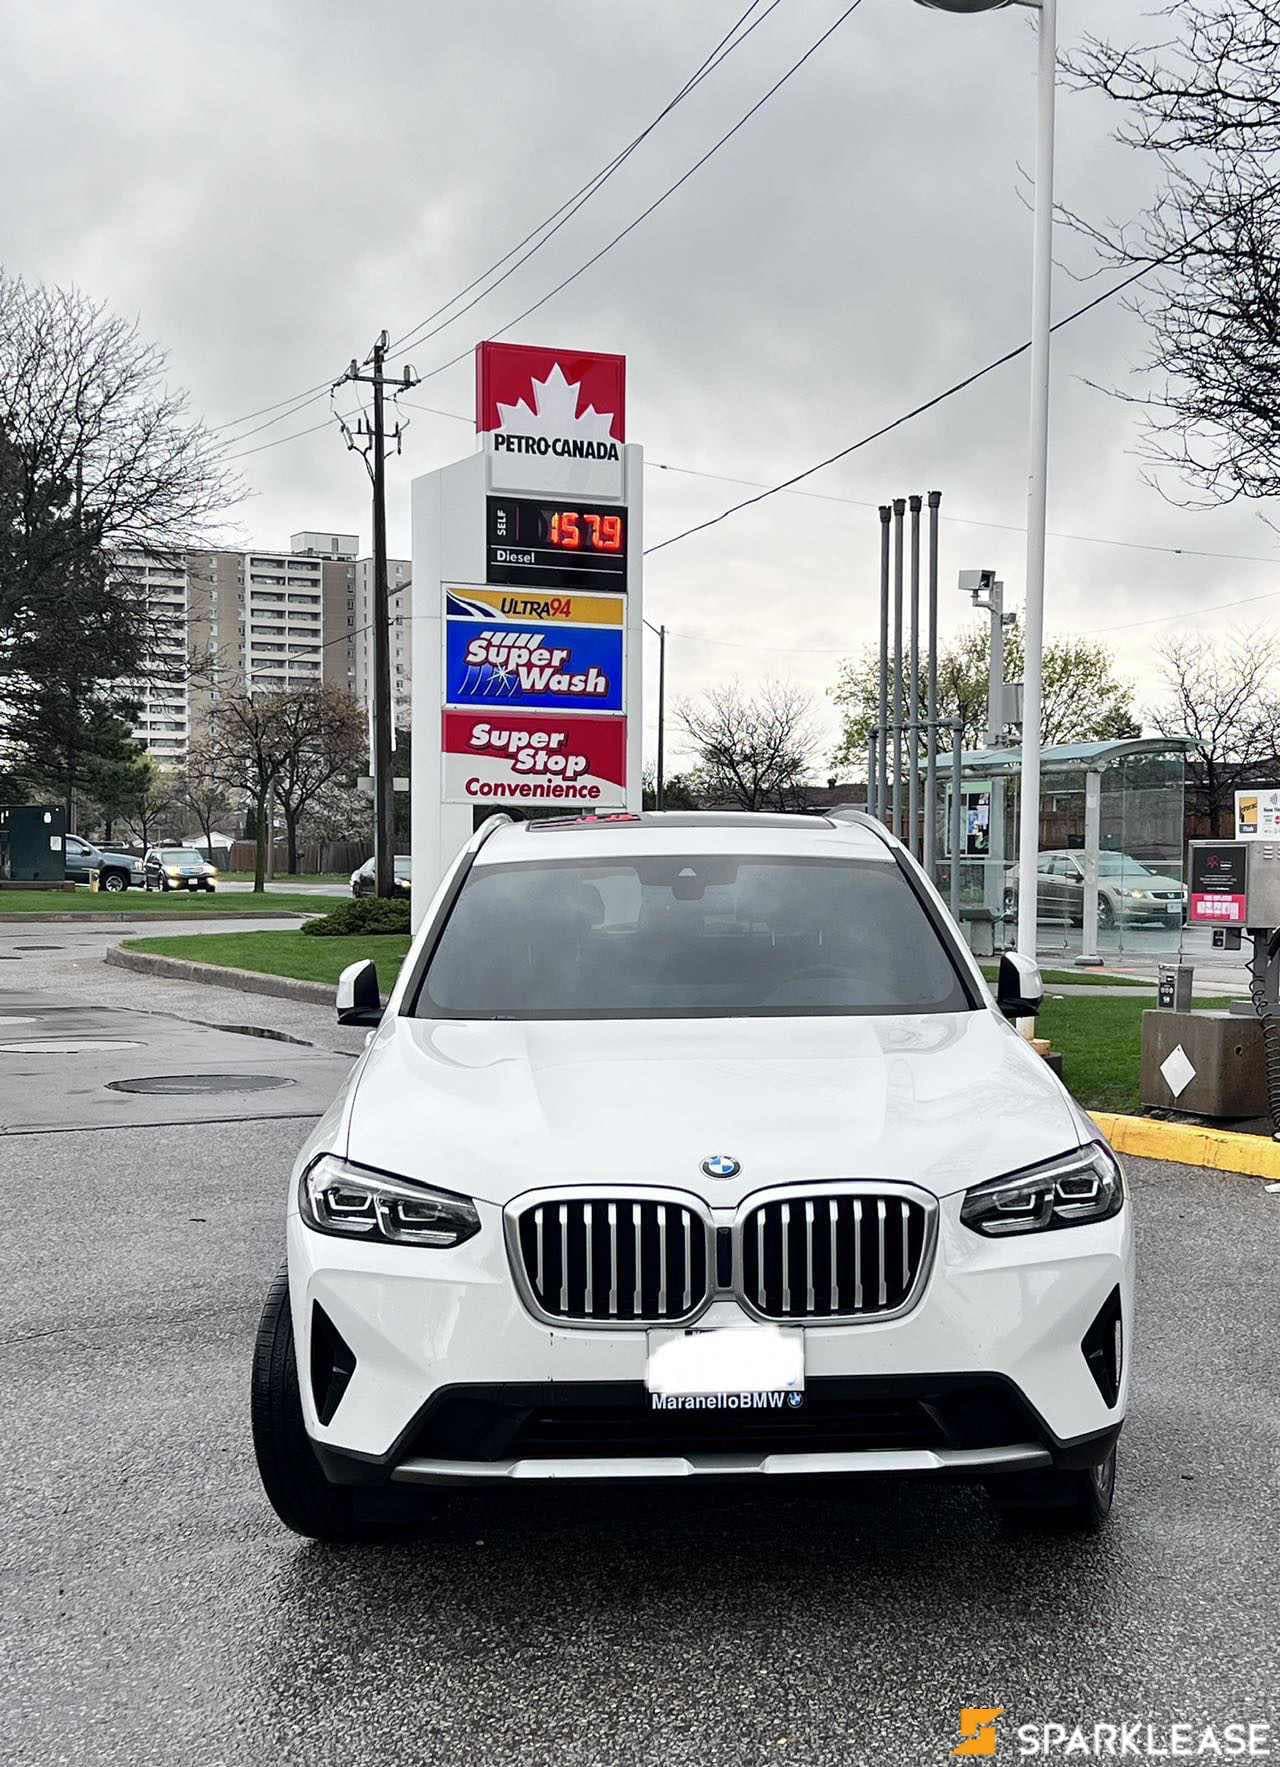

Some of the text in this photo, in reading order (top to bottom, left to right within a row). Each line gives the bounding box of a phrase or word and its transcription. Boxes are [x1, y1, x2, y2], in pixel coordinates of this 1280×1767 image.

[497, 509, 506, 536] SELF
[496, 550, 536, 564] Diesel
[466, 639, 568, 669] Super
[518, 666, 607, 694] Wash
[470, 723, 565, 752] Super
[515, 749, 587, 779] Stop
[465, 777, 601, 799] Convenience
